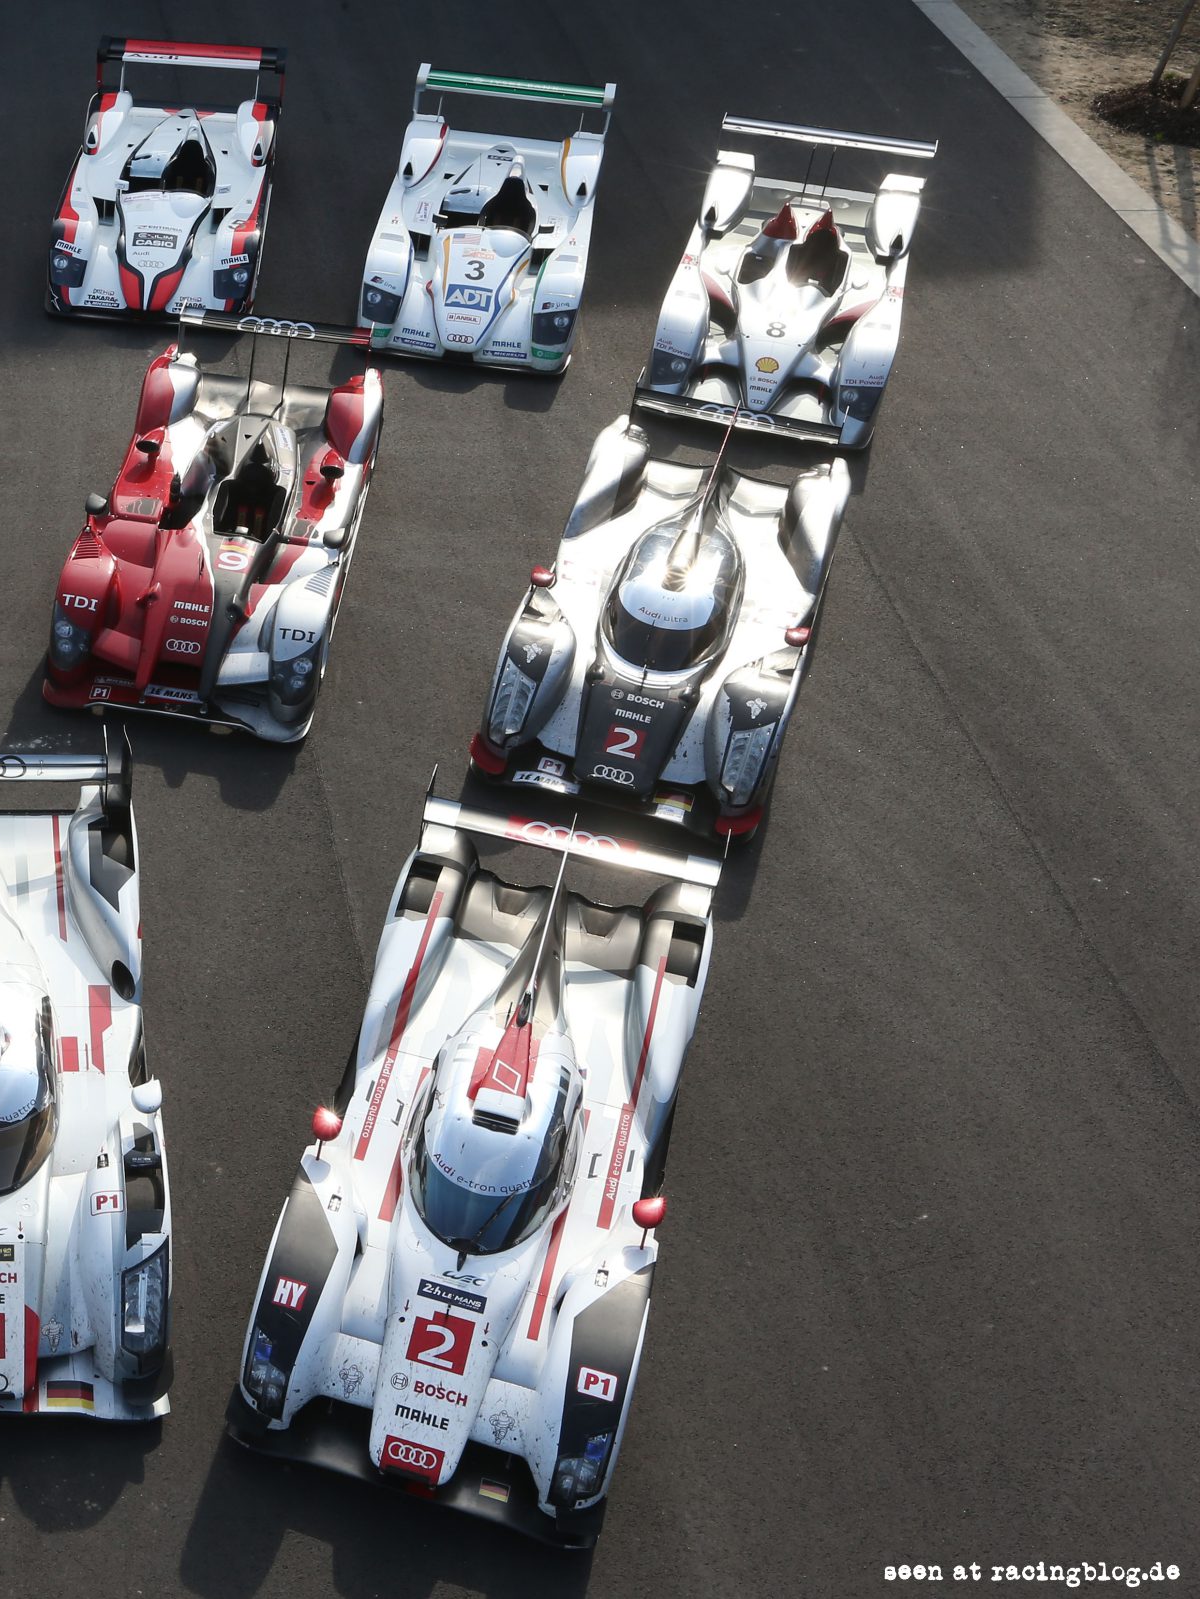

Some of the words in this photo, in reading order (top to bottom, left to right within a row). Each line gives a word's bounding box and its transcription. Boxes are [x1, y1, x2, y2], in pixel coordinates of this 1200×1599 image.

[57, 240, 83, 254] MAHLE
[135, 240, 174, 248] CASIO
[221, 255, 248, 266] MAHLE
[464, 260, 485, 280] 3
[445, 288, 493, 308] ADT
[401, 327, 431, 339] MAHLE
[766, 321, 787, 338] 8
[492, 340, 522, 349] MAHLE
[749, 384, 773, 394] MAHLE
[757, 376, 778, 385] BOSCH
[217, 552, 249, 572] 9
[62, 593, 99, 612] TDI
[173, 600, 210, 613] MAHLE
[180, 617, 208, 627] BOSCH
[638, 606, 662, 620] Audi
[662, 615, 689, 624] ultra
[279, 628, 317, 644] TDI
[93, 687, 108, 697] P1
[150, 687, 162, 695] LE
[163, 689, 194, 700] MANS
[626, 692, 665, 710] BOSCH
[614, 708, 652, 724] MAHLE
[605, 726, 640, 759] 2
[542, 758, 563, 774] P1
[382, 1056, 395, 1078] Audi
[373, 1077, 389, 1103] e-tron
[361, 1104, 379, 1139] quattro
[618, 1113, 631, 1147] quattro
[612, 1146, 626, 1177] e-tron
[433, 1152, 456, 1177] Audi
[456, 1175, 496, 1193] e-tron
[606, 1177, 619, 1201] Audi
[96, 1194, 119, 1210] P1
[273, 1278, 307, 1308] HY
[441, 1291, 453, 1299] LE
[454, 1295, 482, 1308] MANS
[417, 1324, 456, 1369] 2
[583, 1372, 611, 1396] P1
[413, 1380, 469, 1407] BOSCH
[394, 1404, 450, 1431] MAHLE
